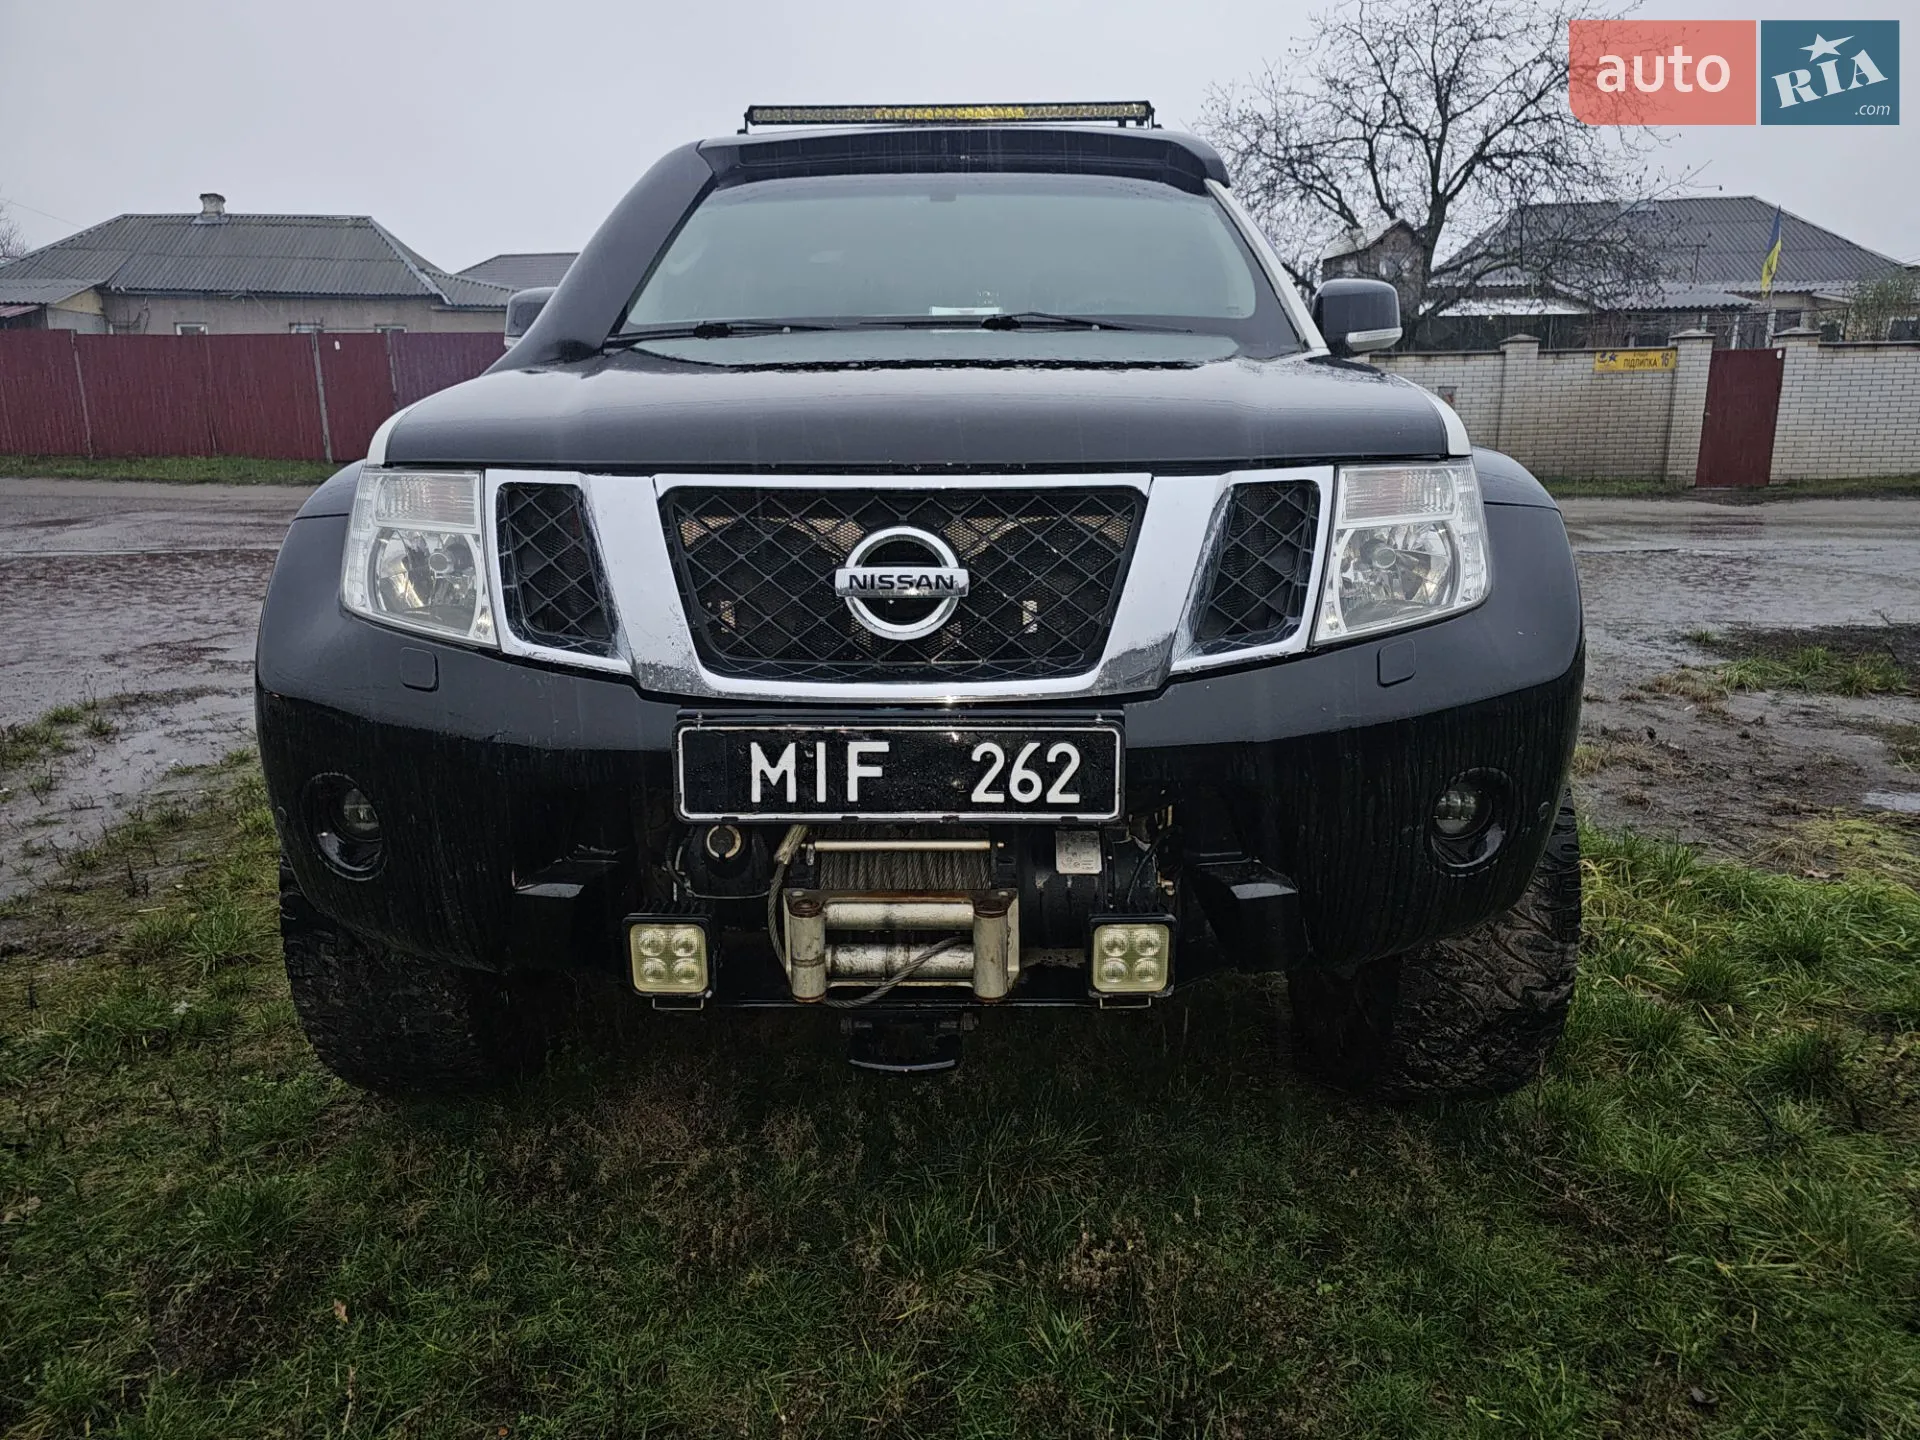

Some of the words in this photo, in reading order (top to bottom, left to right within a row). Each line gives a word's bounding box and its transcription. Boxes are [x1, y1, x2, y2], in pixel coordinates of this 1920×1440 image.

[849, 574, 955, 590] NISSAN
[750, 741, 890, 802] MIF
[970, 742, 1080, 803] 262
